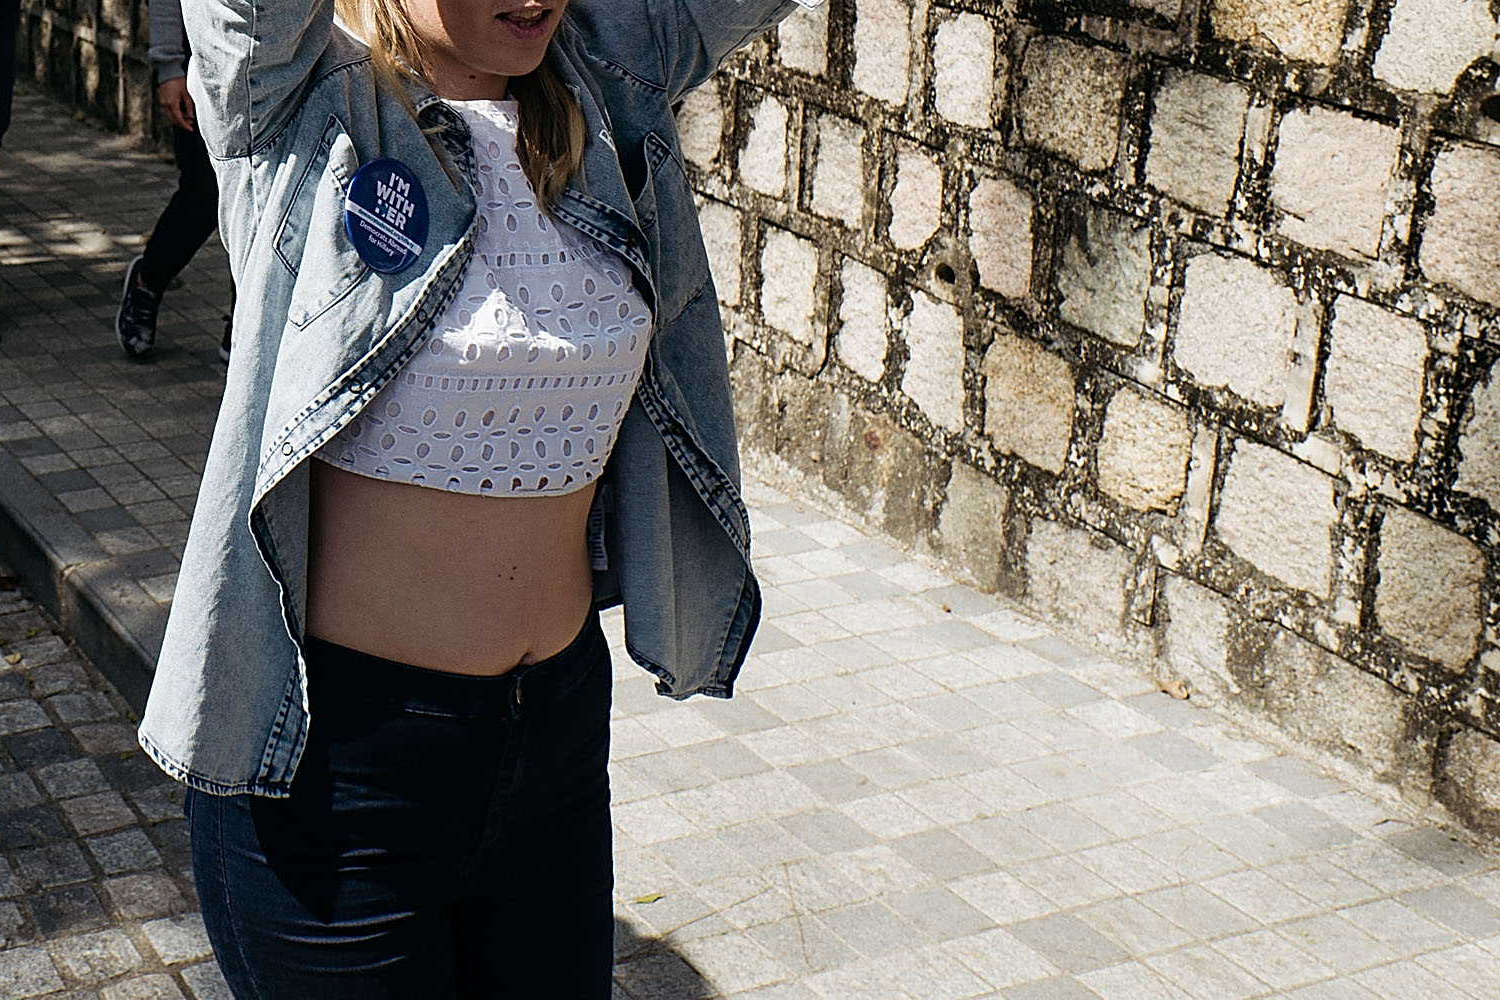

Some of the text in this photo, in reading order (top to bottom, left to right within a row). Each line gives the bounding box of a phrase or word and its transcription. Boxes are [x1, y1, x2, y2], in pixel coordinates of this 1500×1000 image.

[376, 180, 415, 218] WITH
[388, 171, 411, 198] I'M
[375, 199, 407, 231] HER
[359, 219, 408, 256] Democrats Abroad
[368, 233, 395, 257] for Hillary
